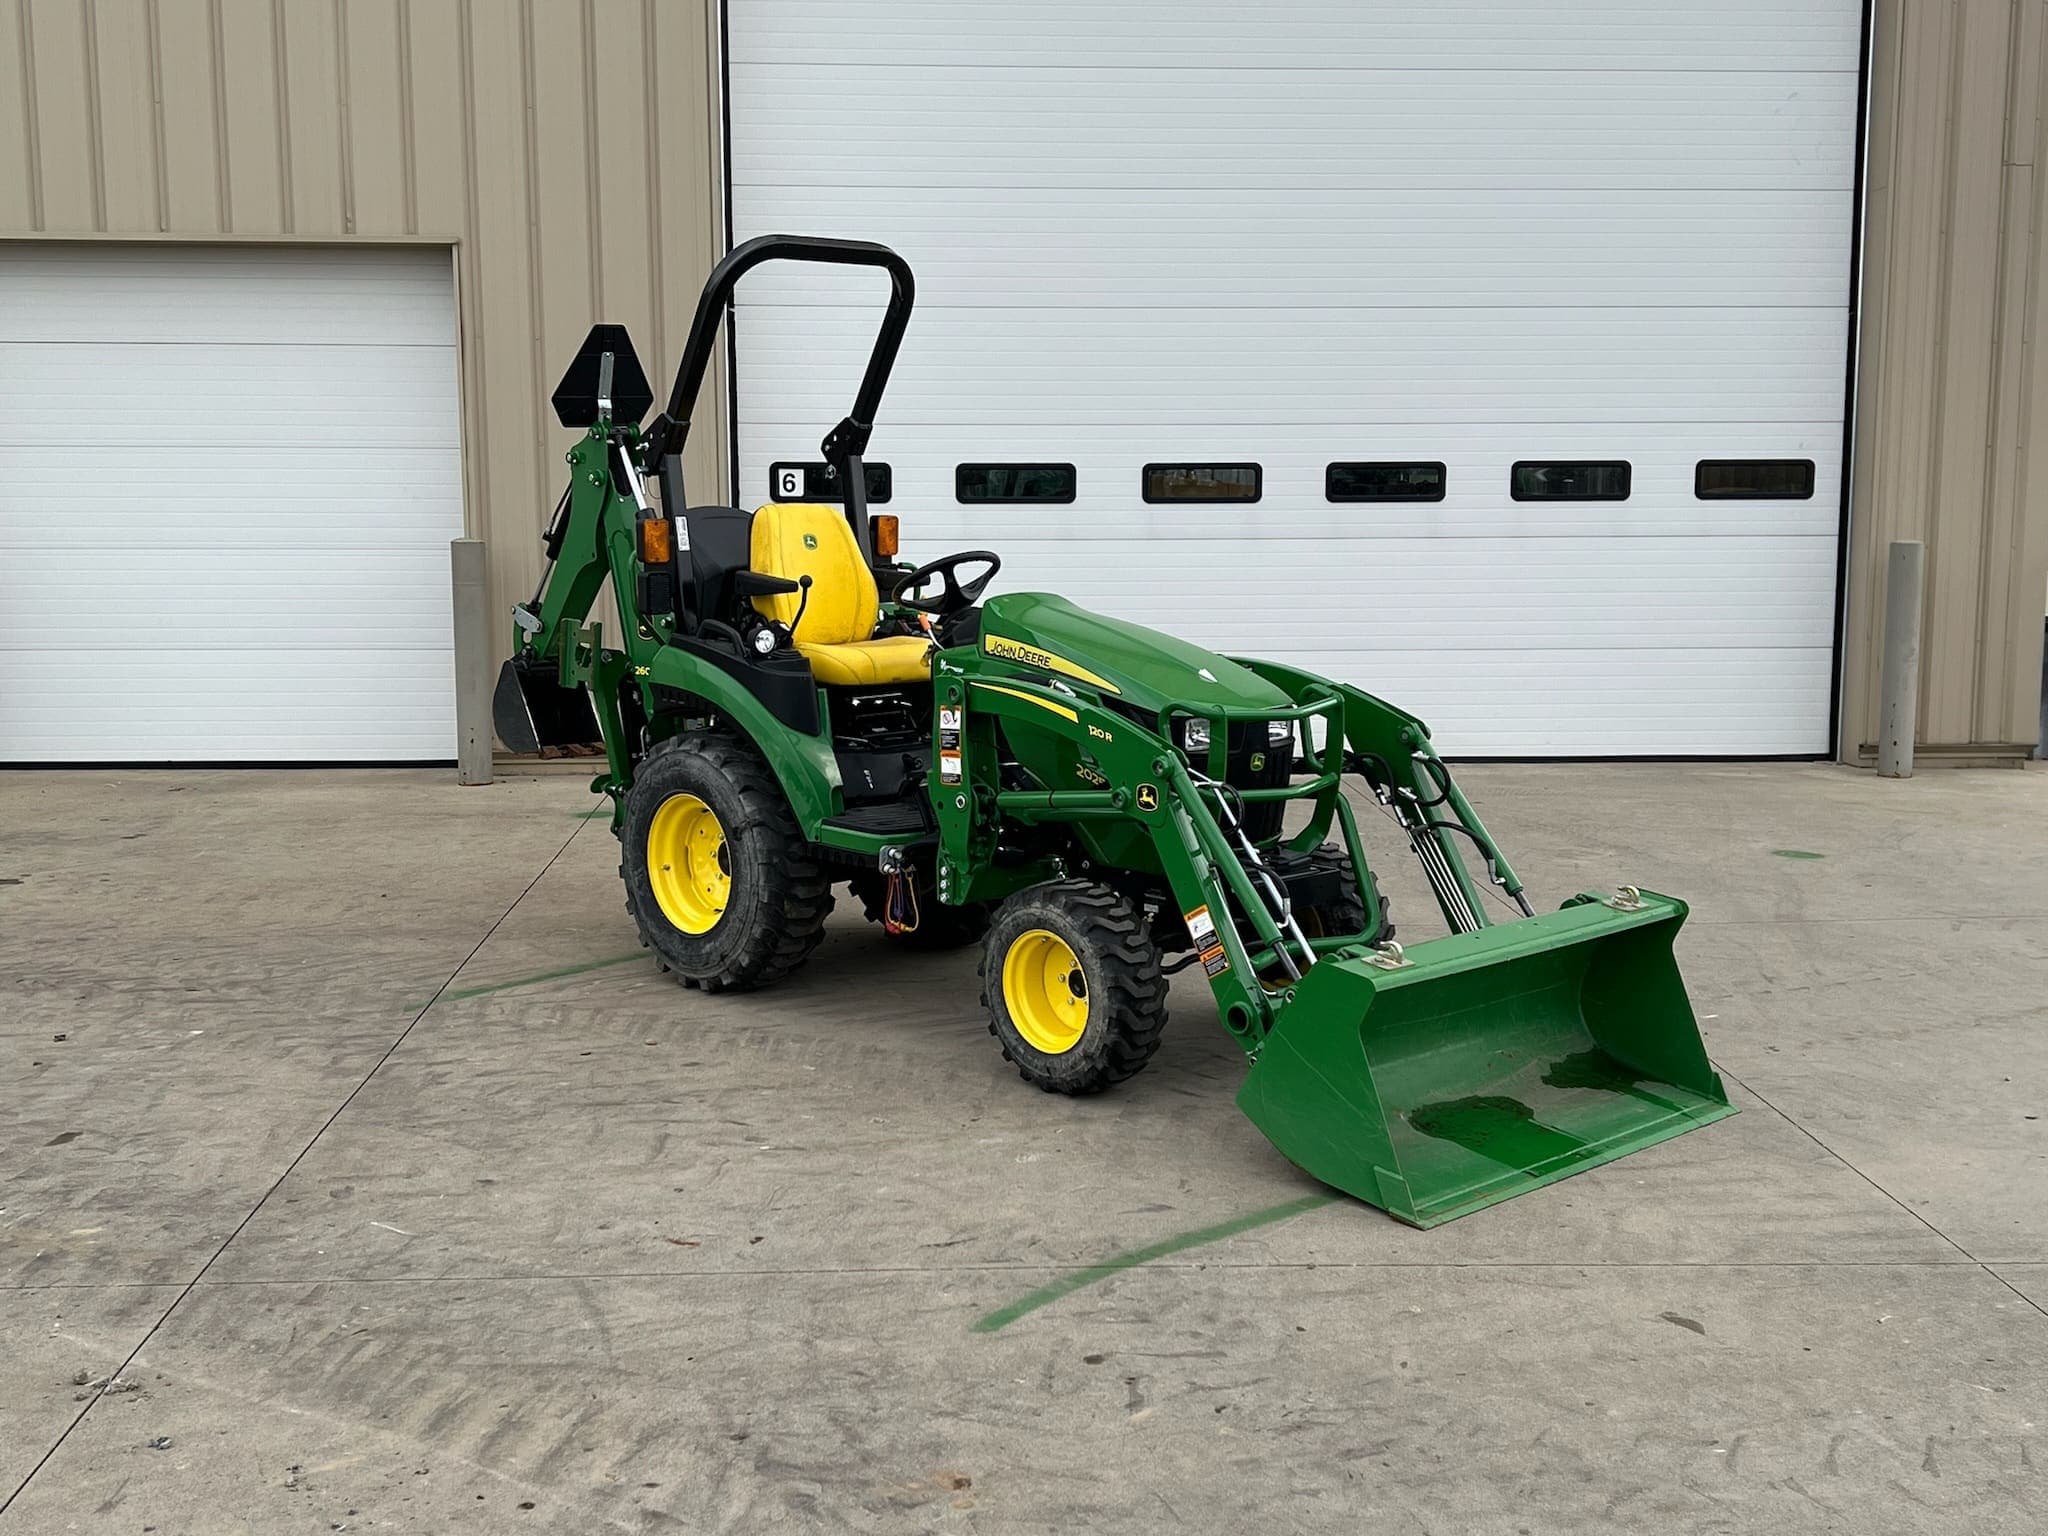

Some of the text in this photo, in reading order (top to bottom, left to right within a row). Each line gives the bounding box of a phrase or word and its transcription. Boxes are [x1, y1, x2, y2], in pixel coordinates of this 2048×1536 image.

[783, 473, 796, 493] 6
[990, 641, 1051, 667] JOHN DEERE
